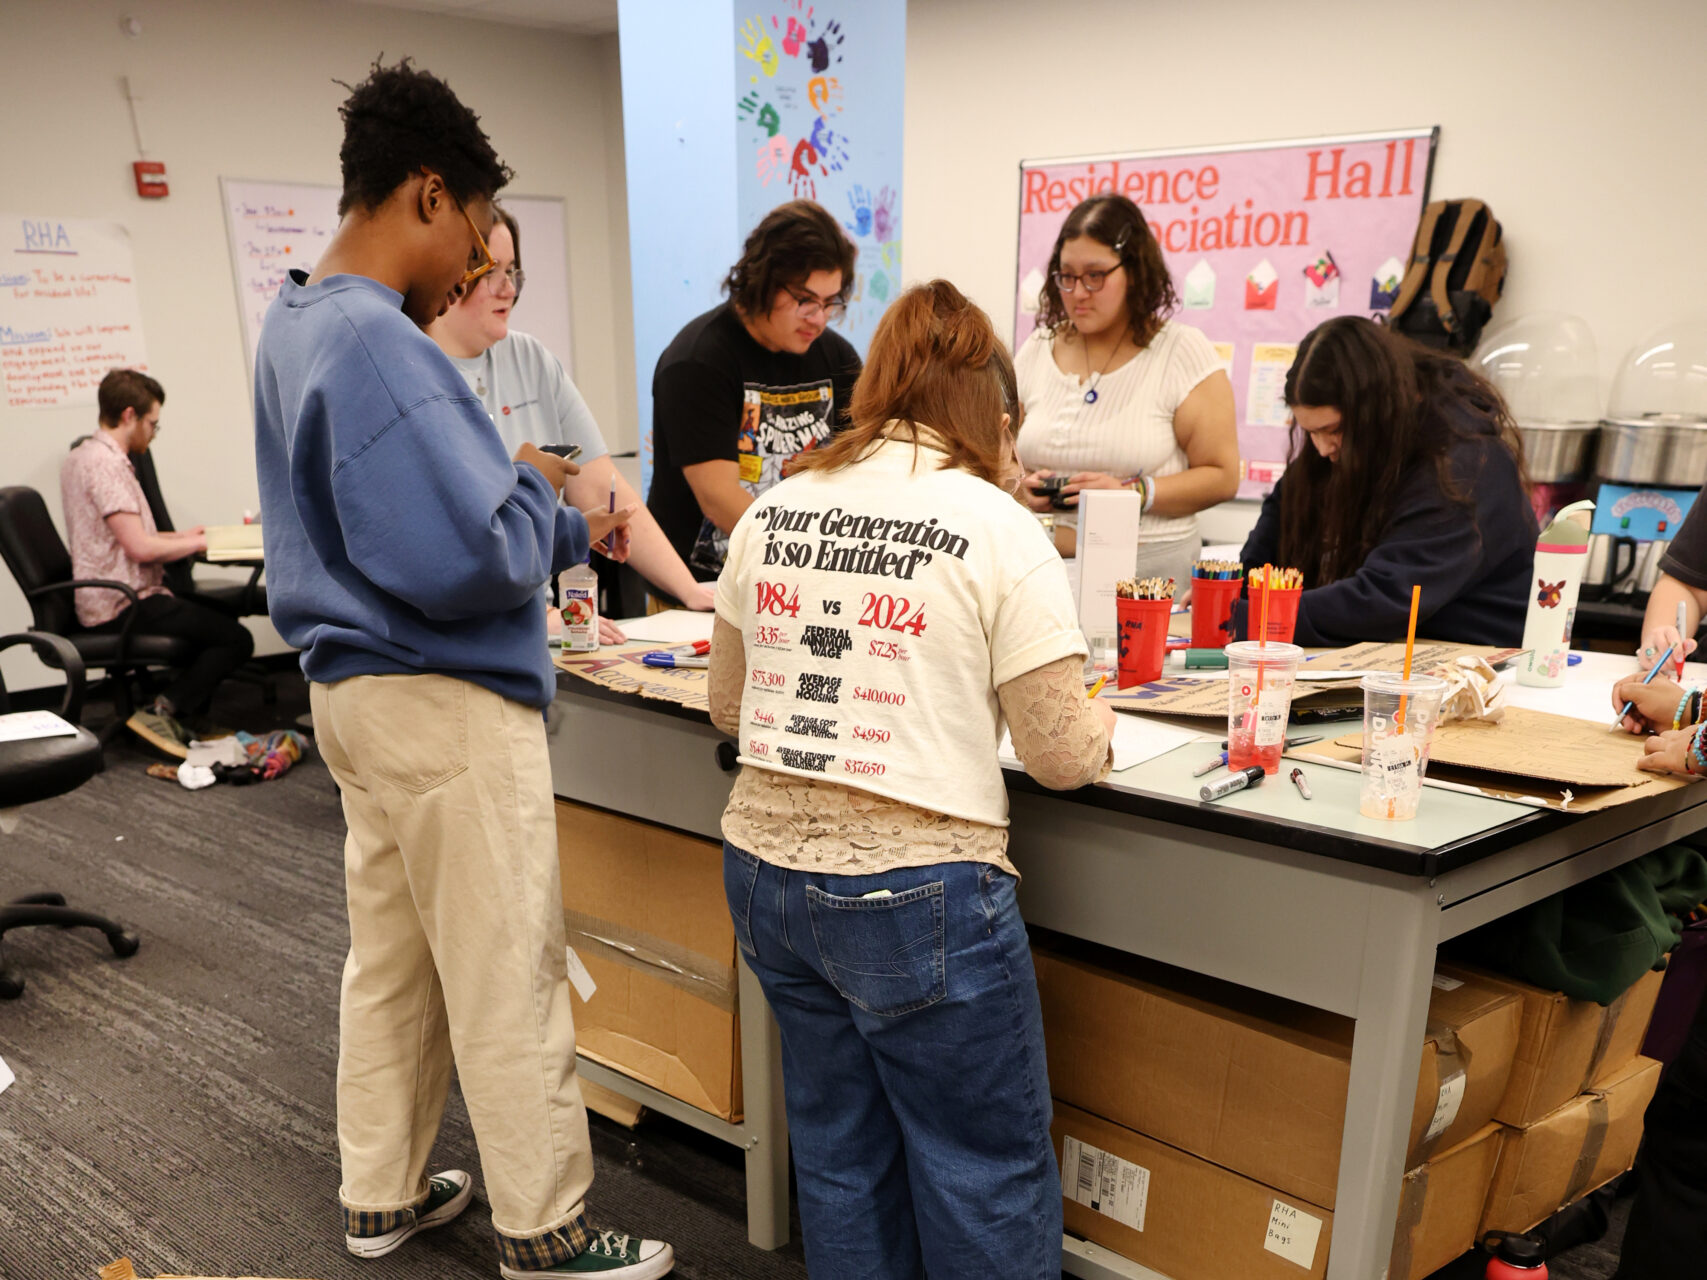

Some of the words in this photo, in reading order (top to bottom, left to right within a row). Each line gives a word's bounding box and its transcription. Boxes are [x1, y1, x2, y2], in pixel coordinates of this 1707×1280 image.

[1022, 162, 1220, 214] Residence
[1304, 139, 1416, 201] Hall
[1149, 198, 1310, 253] ociation
[22, 219, 71, 250] RHA
[819, 508, 970, 560] Generation
[762, 532, 783, 566] is
[781, 541, 812, 568] so
[754, 581, 802, 618] 1984
[822, 600, 842, 615] VS
[857, 592, 927, 637] 2024
[804, 625, 851, 641] FEDERAL
[800, 634, 853, 651] MINIMUM
[811, 645, 842, 659] WAGE
[798, 673, 842, 688] AVERAGE
[800, 682, 824, 695] COST
[826, 685, 838, 695] OF
[796, 689, 839, 704] HOUSING
[790, 714, 819, 725] AVERAGE
[819, 719, 838, 728] COST
[1274, 1203, 1297, 1218] RHA
[1271, 1216, 1290, 1229] Mini
[1268, 1229, 1291, 1244] Bags
